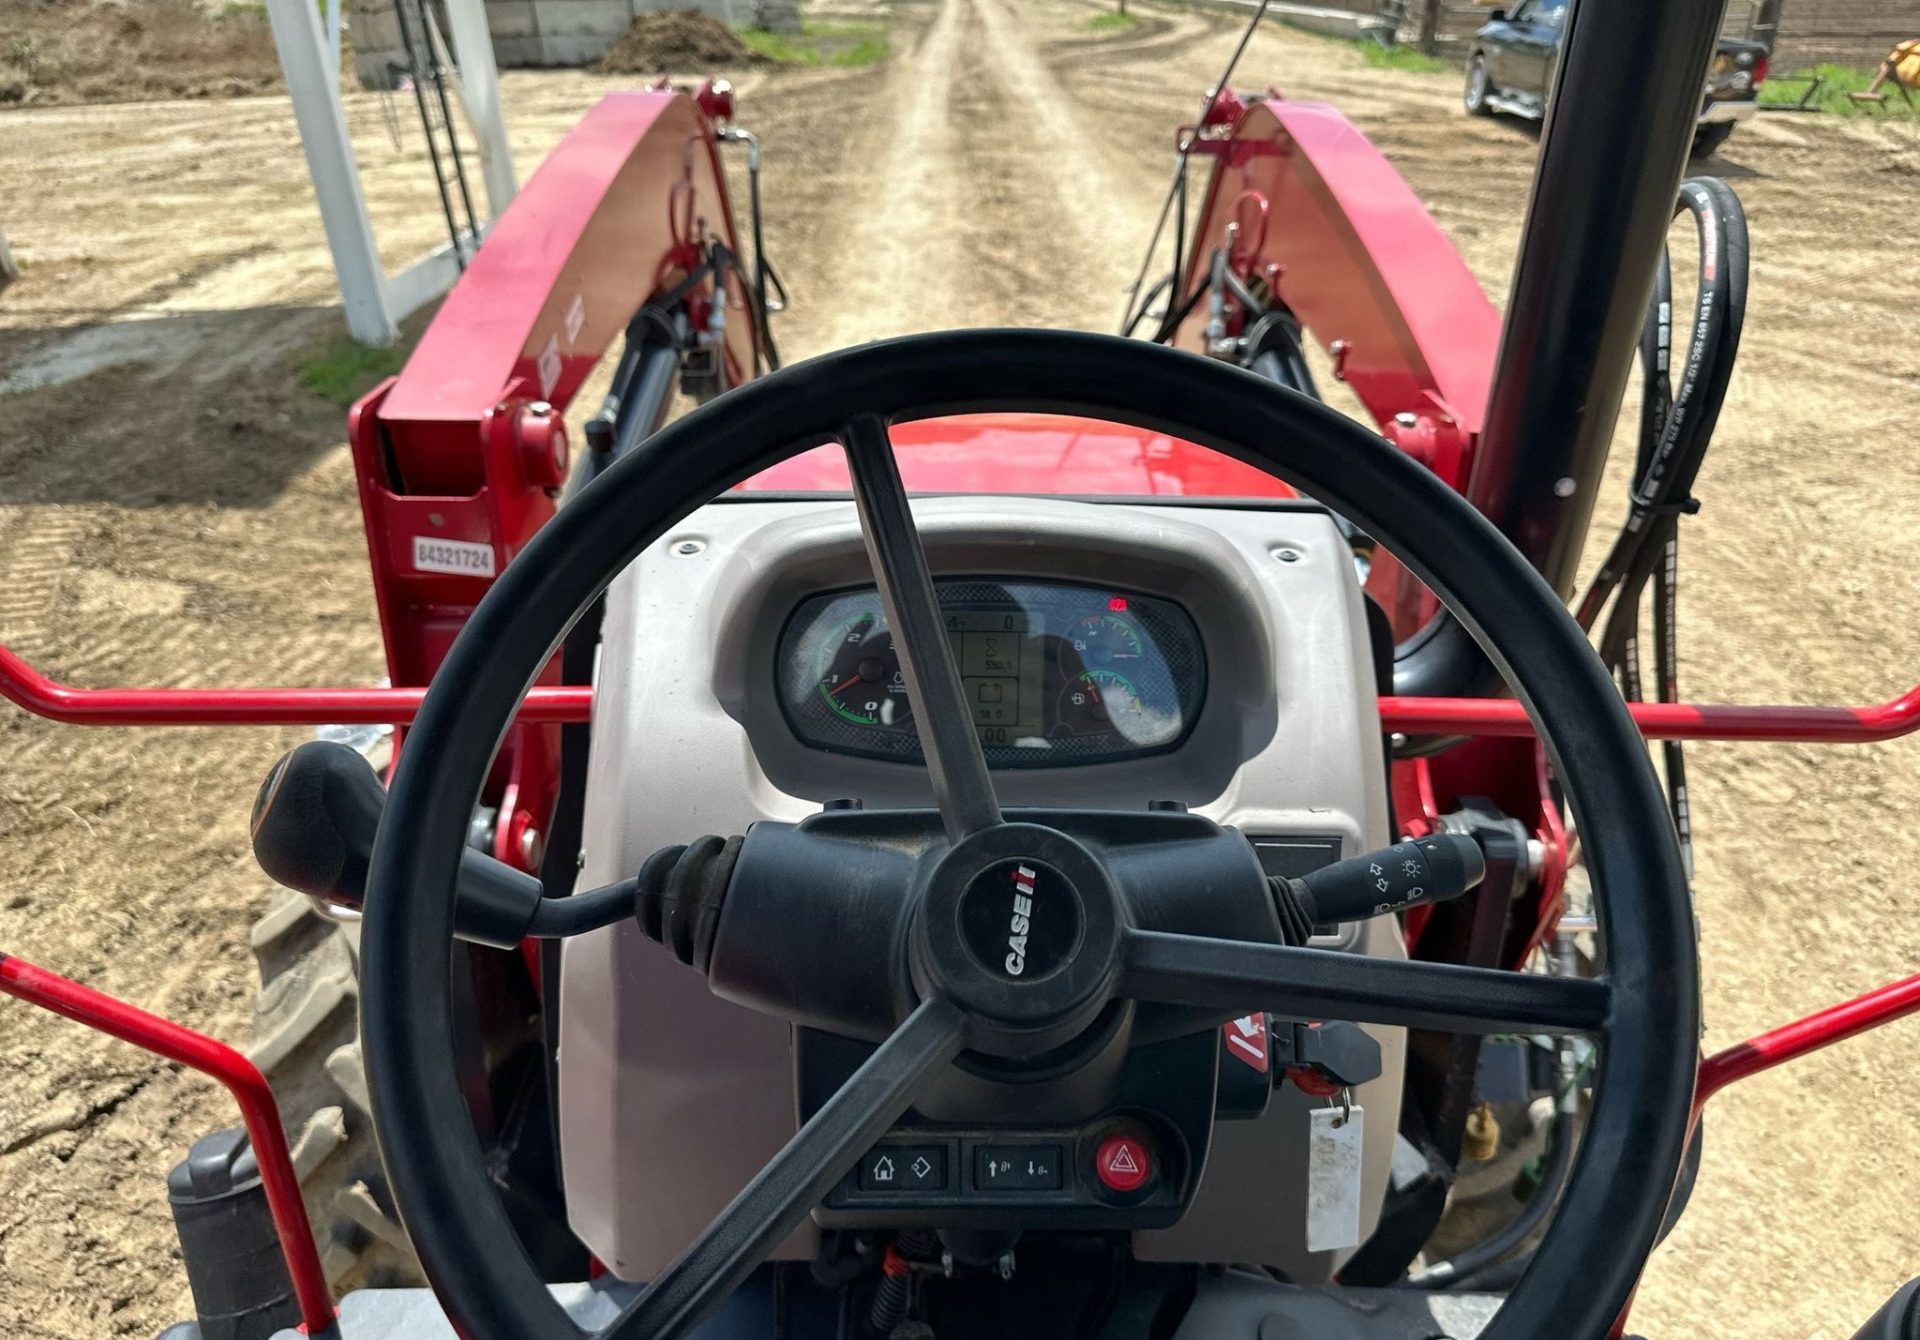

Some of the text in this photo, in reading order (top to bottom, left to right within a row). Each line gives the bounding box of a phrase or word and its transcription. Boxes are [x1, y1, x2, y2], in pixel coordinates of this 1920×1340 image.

[1702, 291, 1713, 305] TS
[1700, 305, 1711, 320] EN
[848, 633, 861, 642] 2
[864, 702, 878, 711] 0
[1005, 893, 1032, 975] CASE
